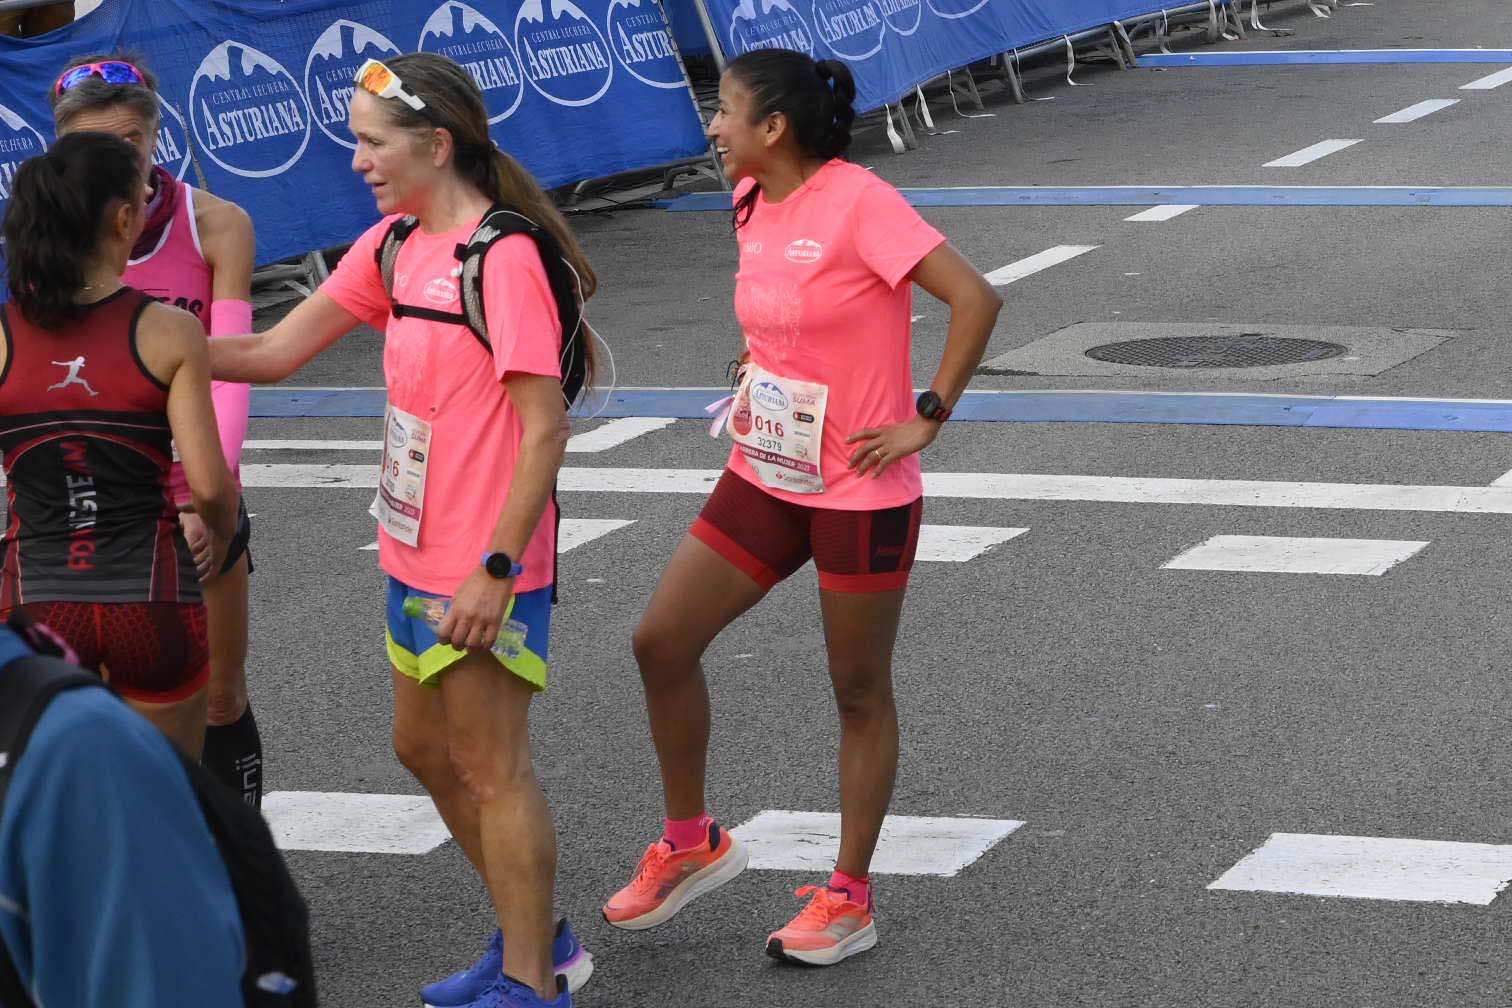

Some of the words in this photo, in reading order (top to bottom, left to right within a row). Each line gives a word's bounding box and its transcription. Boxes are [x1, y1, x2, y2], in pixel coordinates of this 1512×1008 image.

[532, 29, 561, 42] CENTRAL
[561, 24, 592, 39] LECHERA
[524, 36, 609, 81] ASTURIANA
[213, 88, 252, 104] CENTRAL
[253, 80, 289, 97] LECHERA
[200, 98, 305, 150] ASTURIANA
[755, 415, 785, 438] 016
